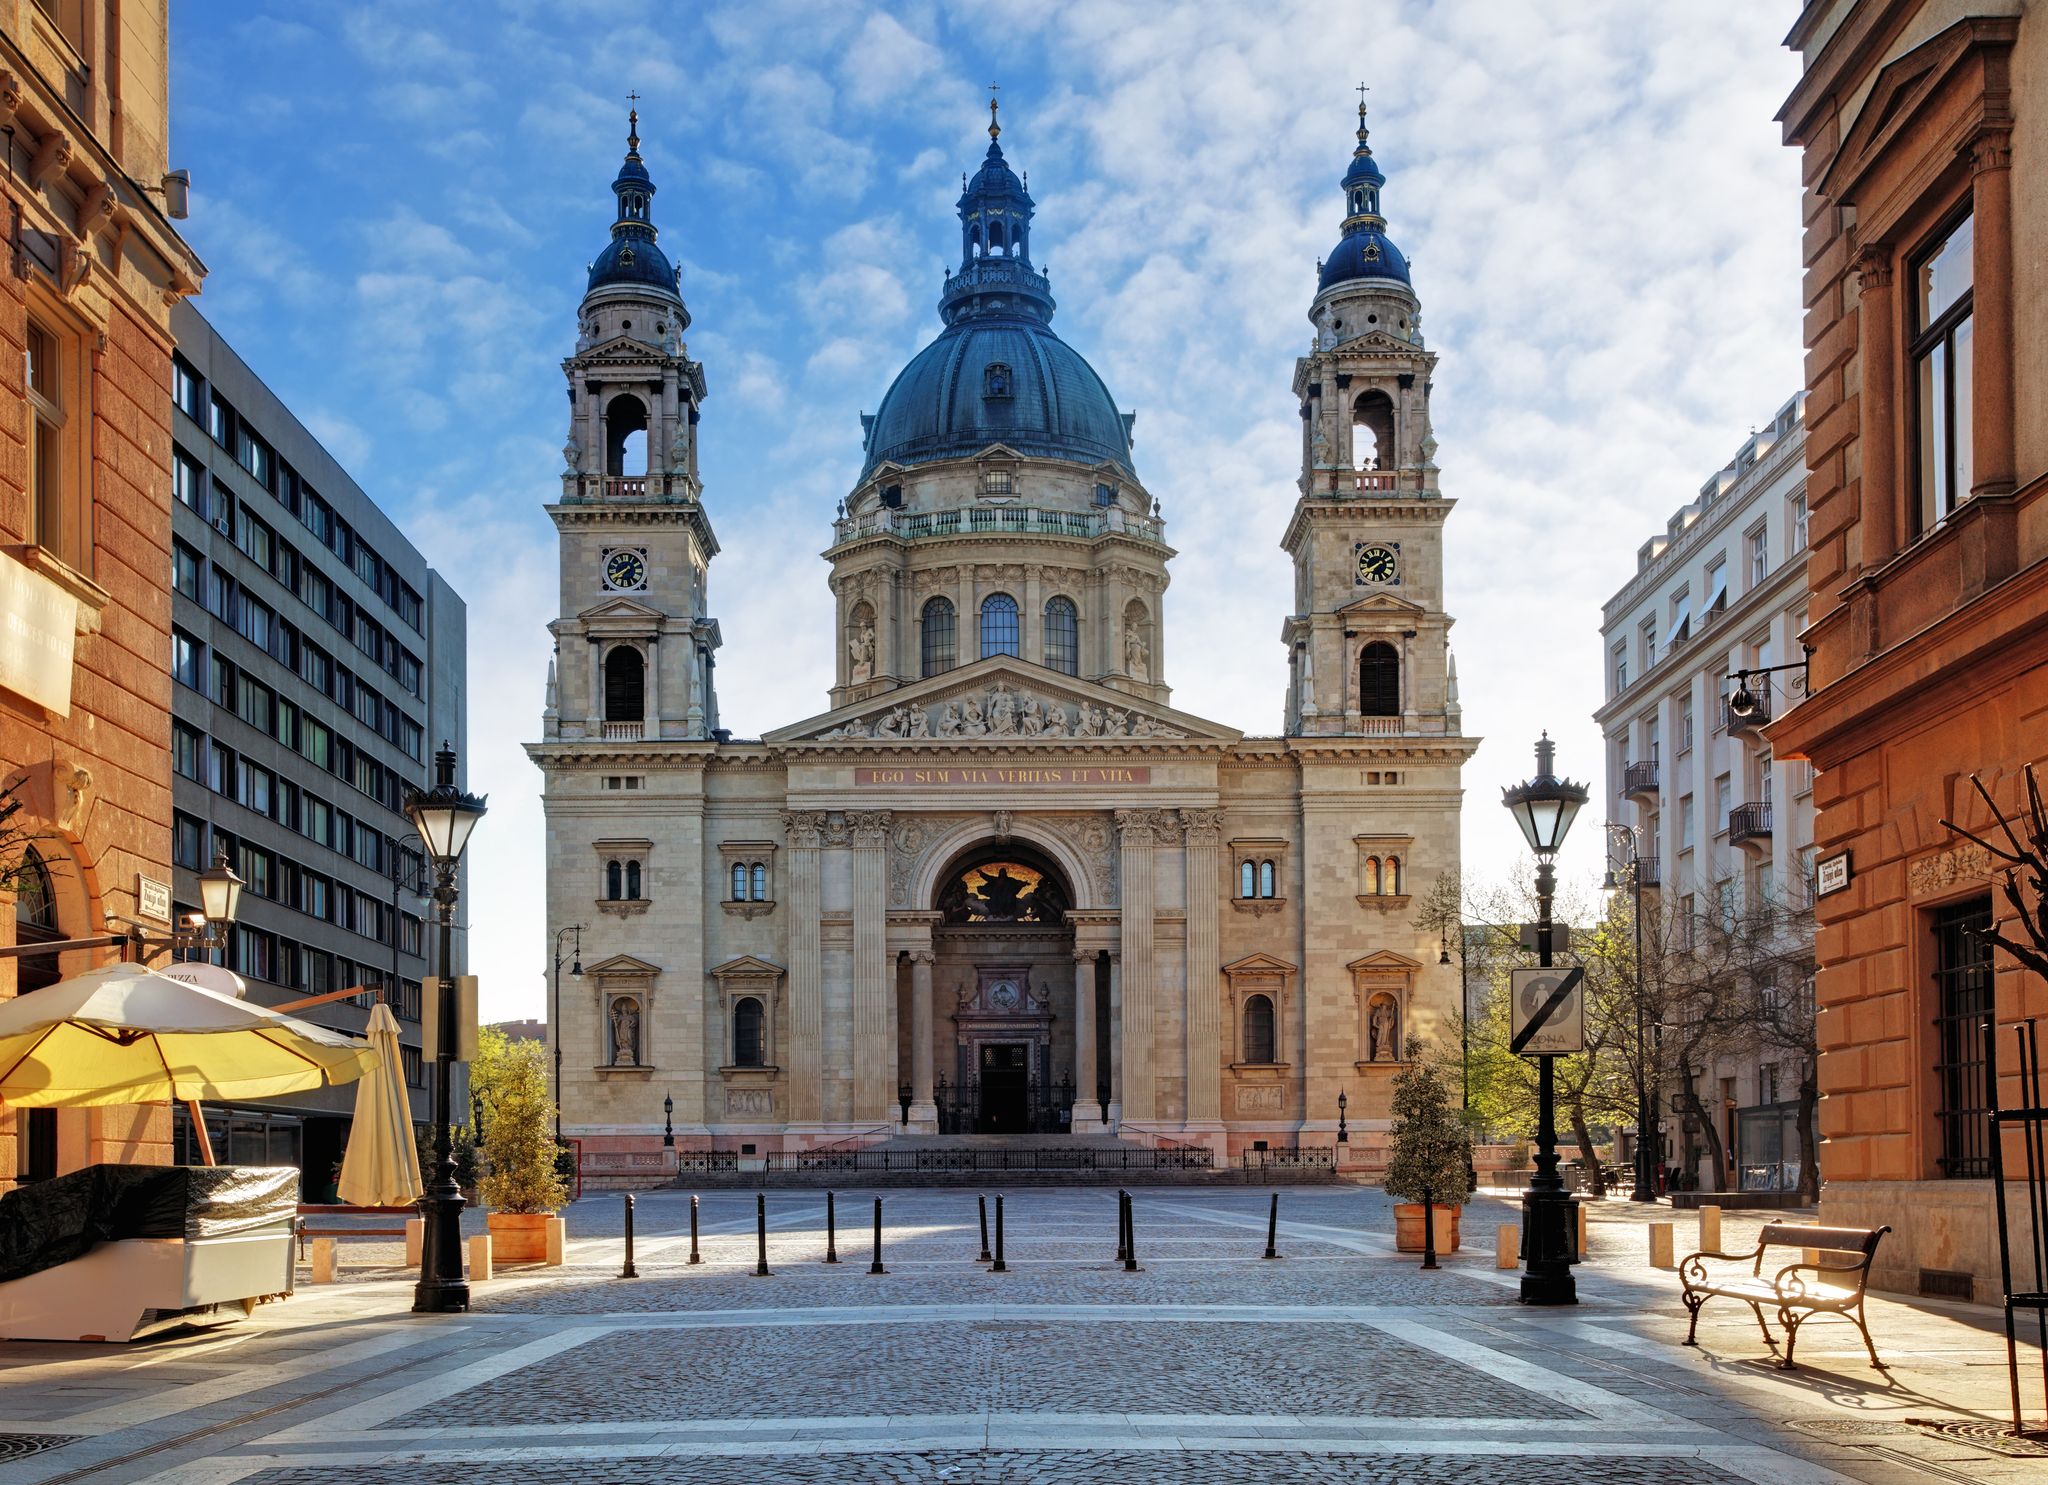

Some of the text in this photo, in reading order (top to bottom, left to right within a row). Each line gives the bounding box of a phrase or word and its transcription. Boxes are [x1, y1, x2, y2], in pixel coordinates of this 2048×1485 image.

[872, 770, 1132, 782] EGO SUM VIA VERITAS ET VITA
